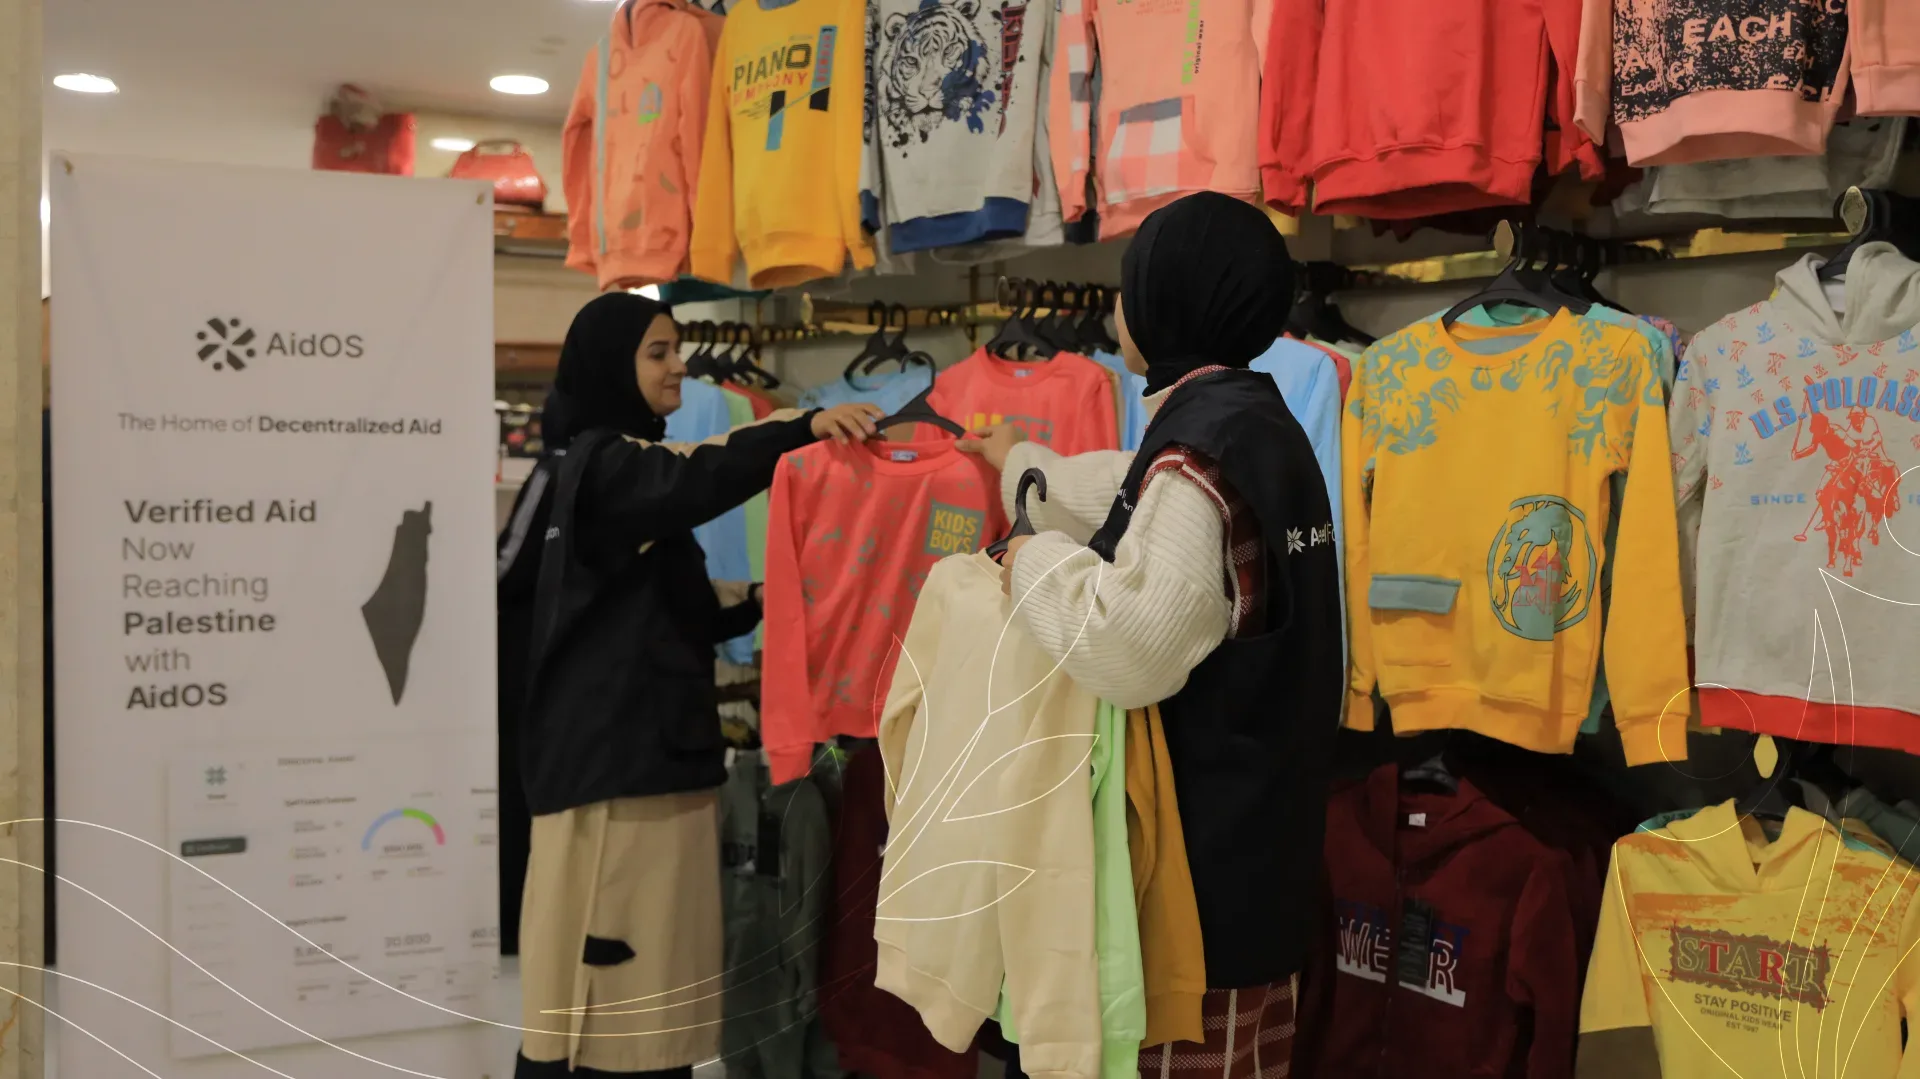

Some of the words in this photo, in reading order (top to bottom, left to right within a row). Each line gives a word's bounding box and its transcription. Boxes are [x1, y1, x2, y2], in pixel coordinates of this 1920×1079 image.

[1682, 11, 1792, 43] EACH
[733, 43, 812, 91] PIANO
[266, 332, 364, 359] AidOS
[1803, 376, 1878, 414] POLO
[117, 412, 157, 431] The
[161, 414, 228, 432] Home
[231, 415, 252, 432] of
[258, 416, 404, 434] Decentralized
[408, 418, 443, 435] Aid
[124, 499, 255, 524] Verified
[264, 499, 317, 523] Aid
[1750, 493, 1807, 506] SINCE
[934, 509, 978, 536] KIDS
[122, 536, 195, 561] Now
[122, 573, 269, 602] Reaching
[124, 608, 276, 636] Palestine
[124, 649, 191, 673] with
[126, 683, 228, 710] AidOS
[1676, 936, 1819, 992] START
[1694, 993, 1727, 1008] STAY
[1731, 999, 1793, 1022] POSITIVE
